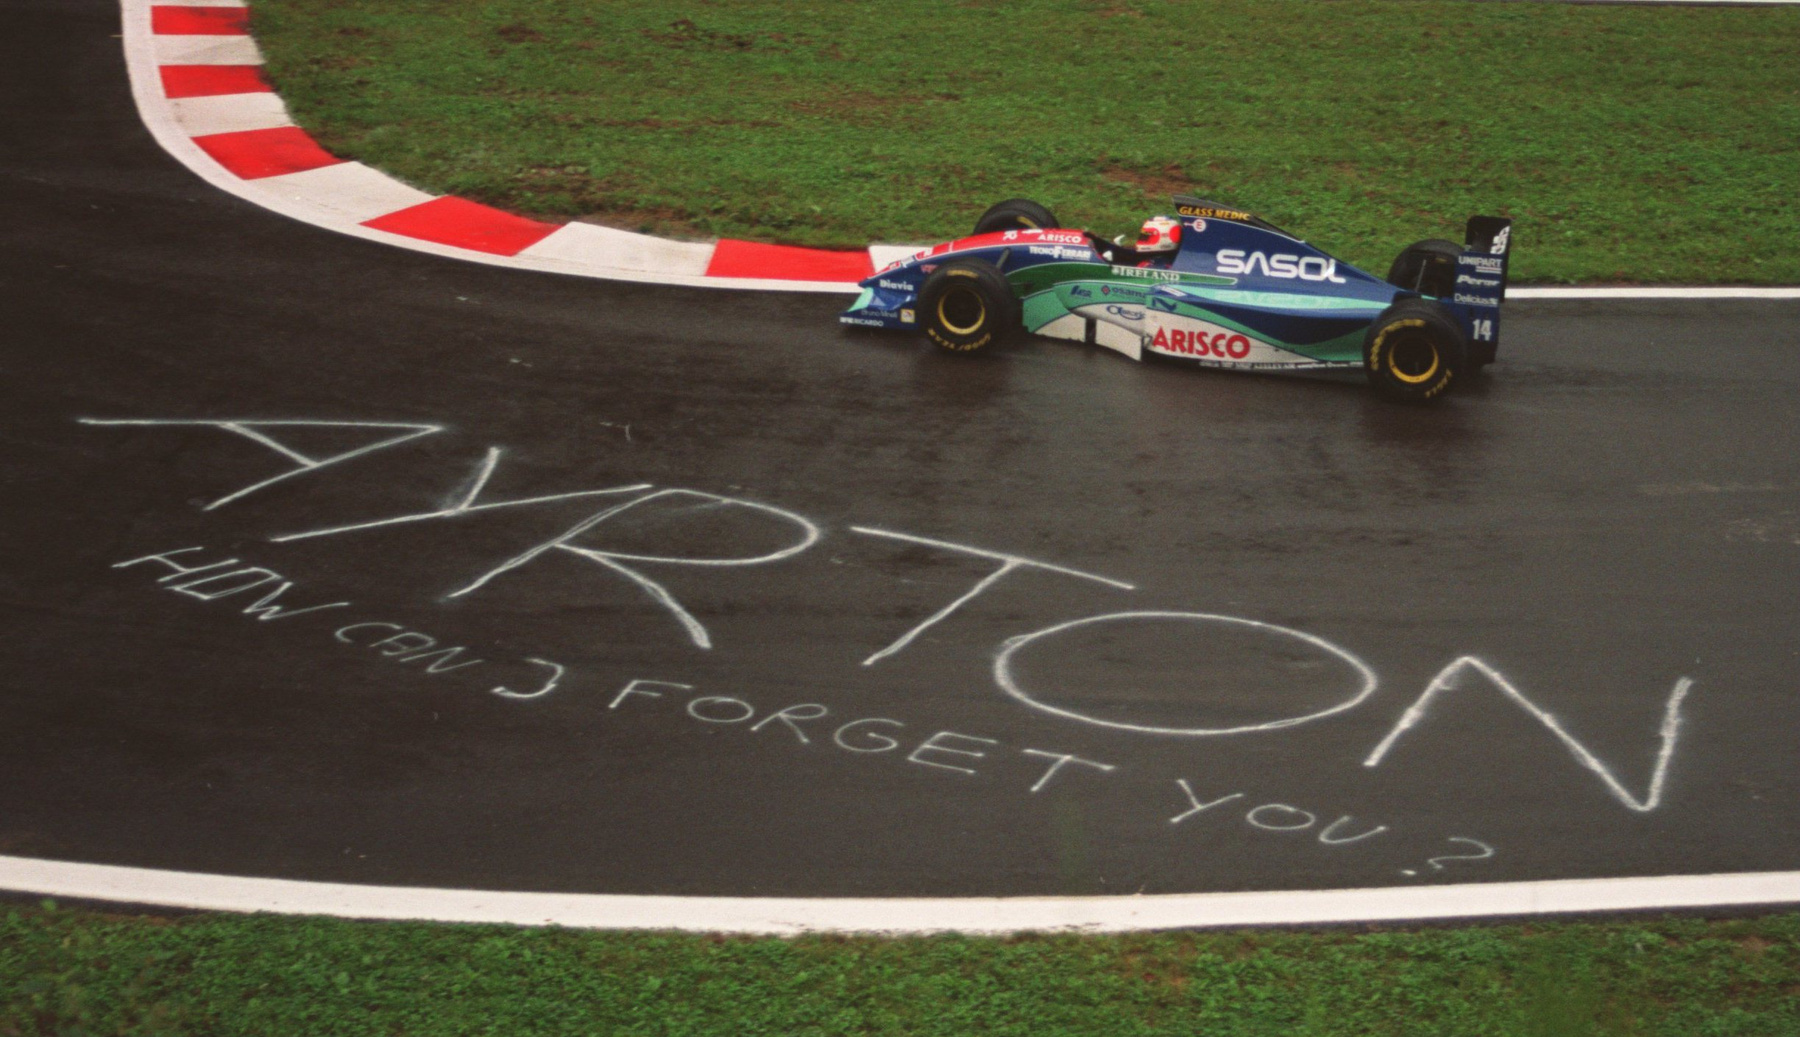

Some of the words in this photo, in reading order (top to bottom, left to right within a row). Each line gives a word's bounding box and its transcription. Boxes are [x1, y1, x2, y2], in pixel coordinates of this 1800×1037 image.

[1178, 206, 1213, 217] GLASS
[1214, 210, 1251, 221] MEDIC
[1037, 234, 1082, 244] ARISCO
[1216, 249, 1346, 284] SASOL
[1458, 256, 1503, 268] UNIPART
[1118, 266, 1180, 281] IRELAND
[879, 279, 914, 292] Diavia
[1472, 318, 1492, 342] 14
[1151, 326, 1251, 360] ARISCO
[78, 417, 1693, 812] AYRTON
[112, 546, 349, 621] HOW
[608, 679, 1115, 792] FORGET
